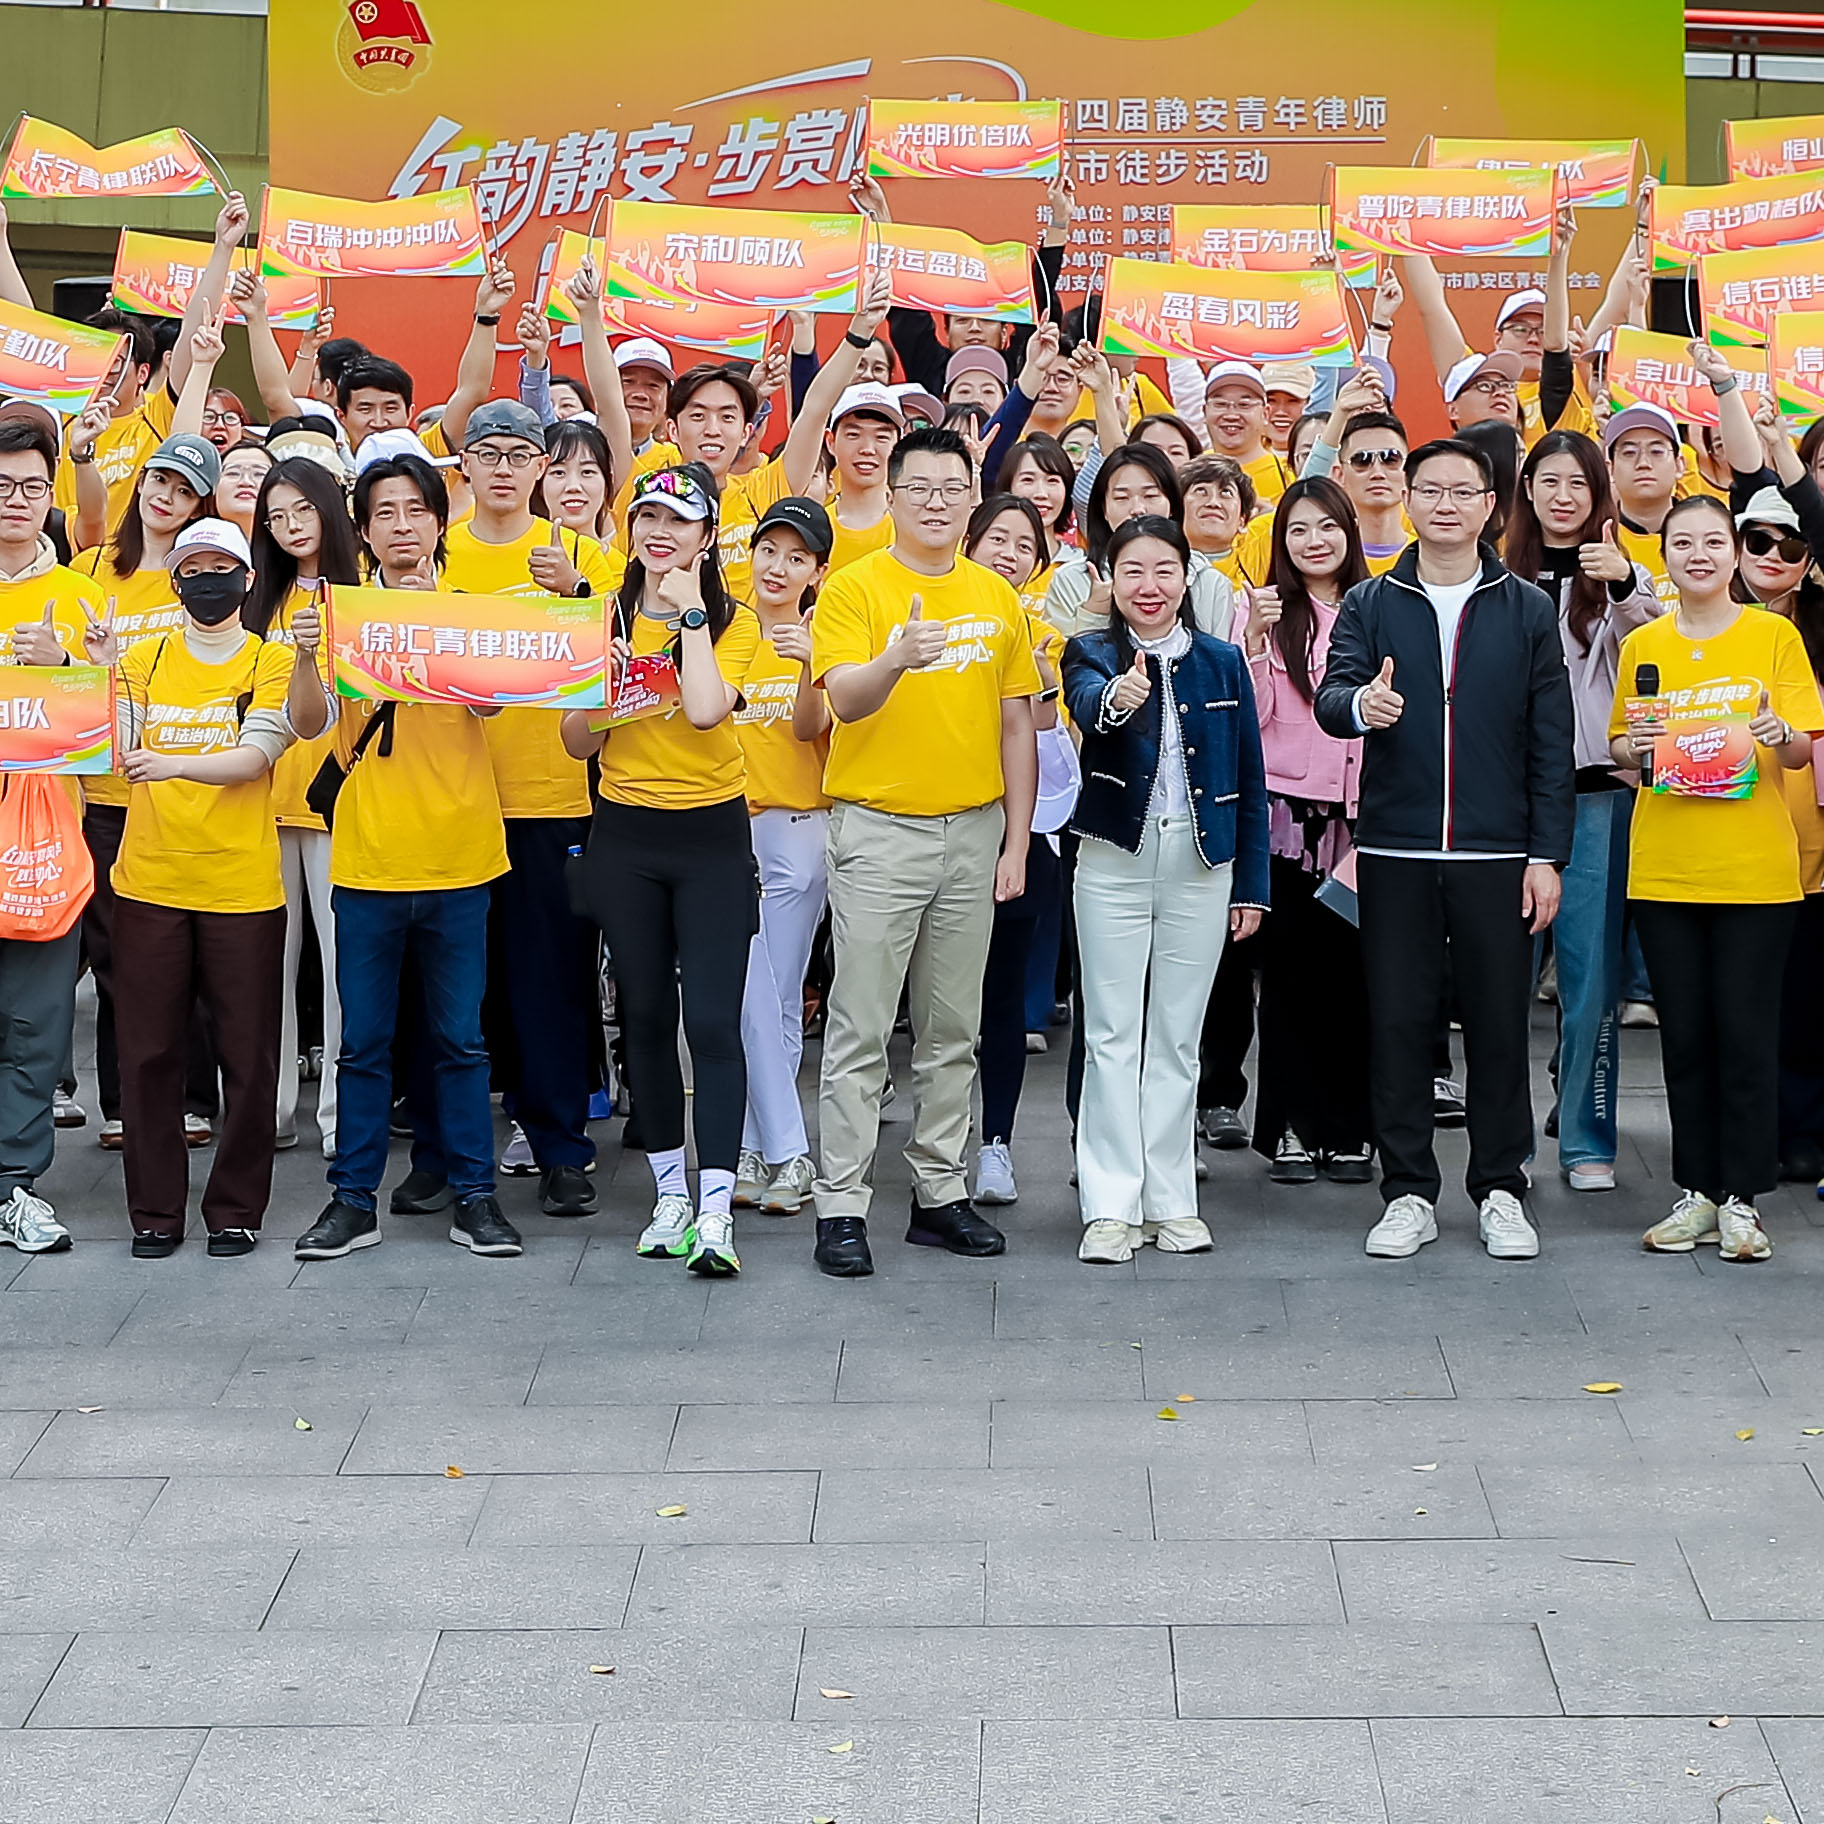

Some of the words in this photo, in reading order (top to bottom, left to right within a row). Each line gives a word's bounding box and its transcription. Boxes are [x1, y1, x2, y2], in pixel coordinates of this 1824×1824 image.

[897, 122, 1032, 147] 光明优倍队
[30, 148, 186, 190] 长宁青律联队
[1358, 194, 1529, 221] 普陀青律联队
[286, 217, 461, 251] 百瑞冲冲冲队
[664, 232, 805, 268] 宋和顾队
[865, 242, 987, 282] 好运盈途
[1160, 291, 1300, 330] 盈春风彩
[360, 620, 575, 661] 徐汇青律联队
